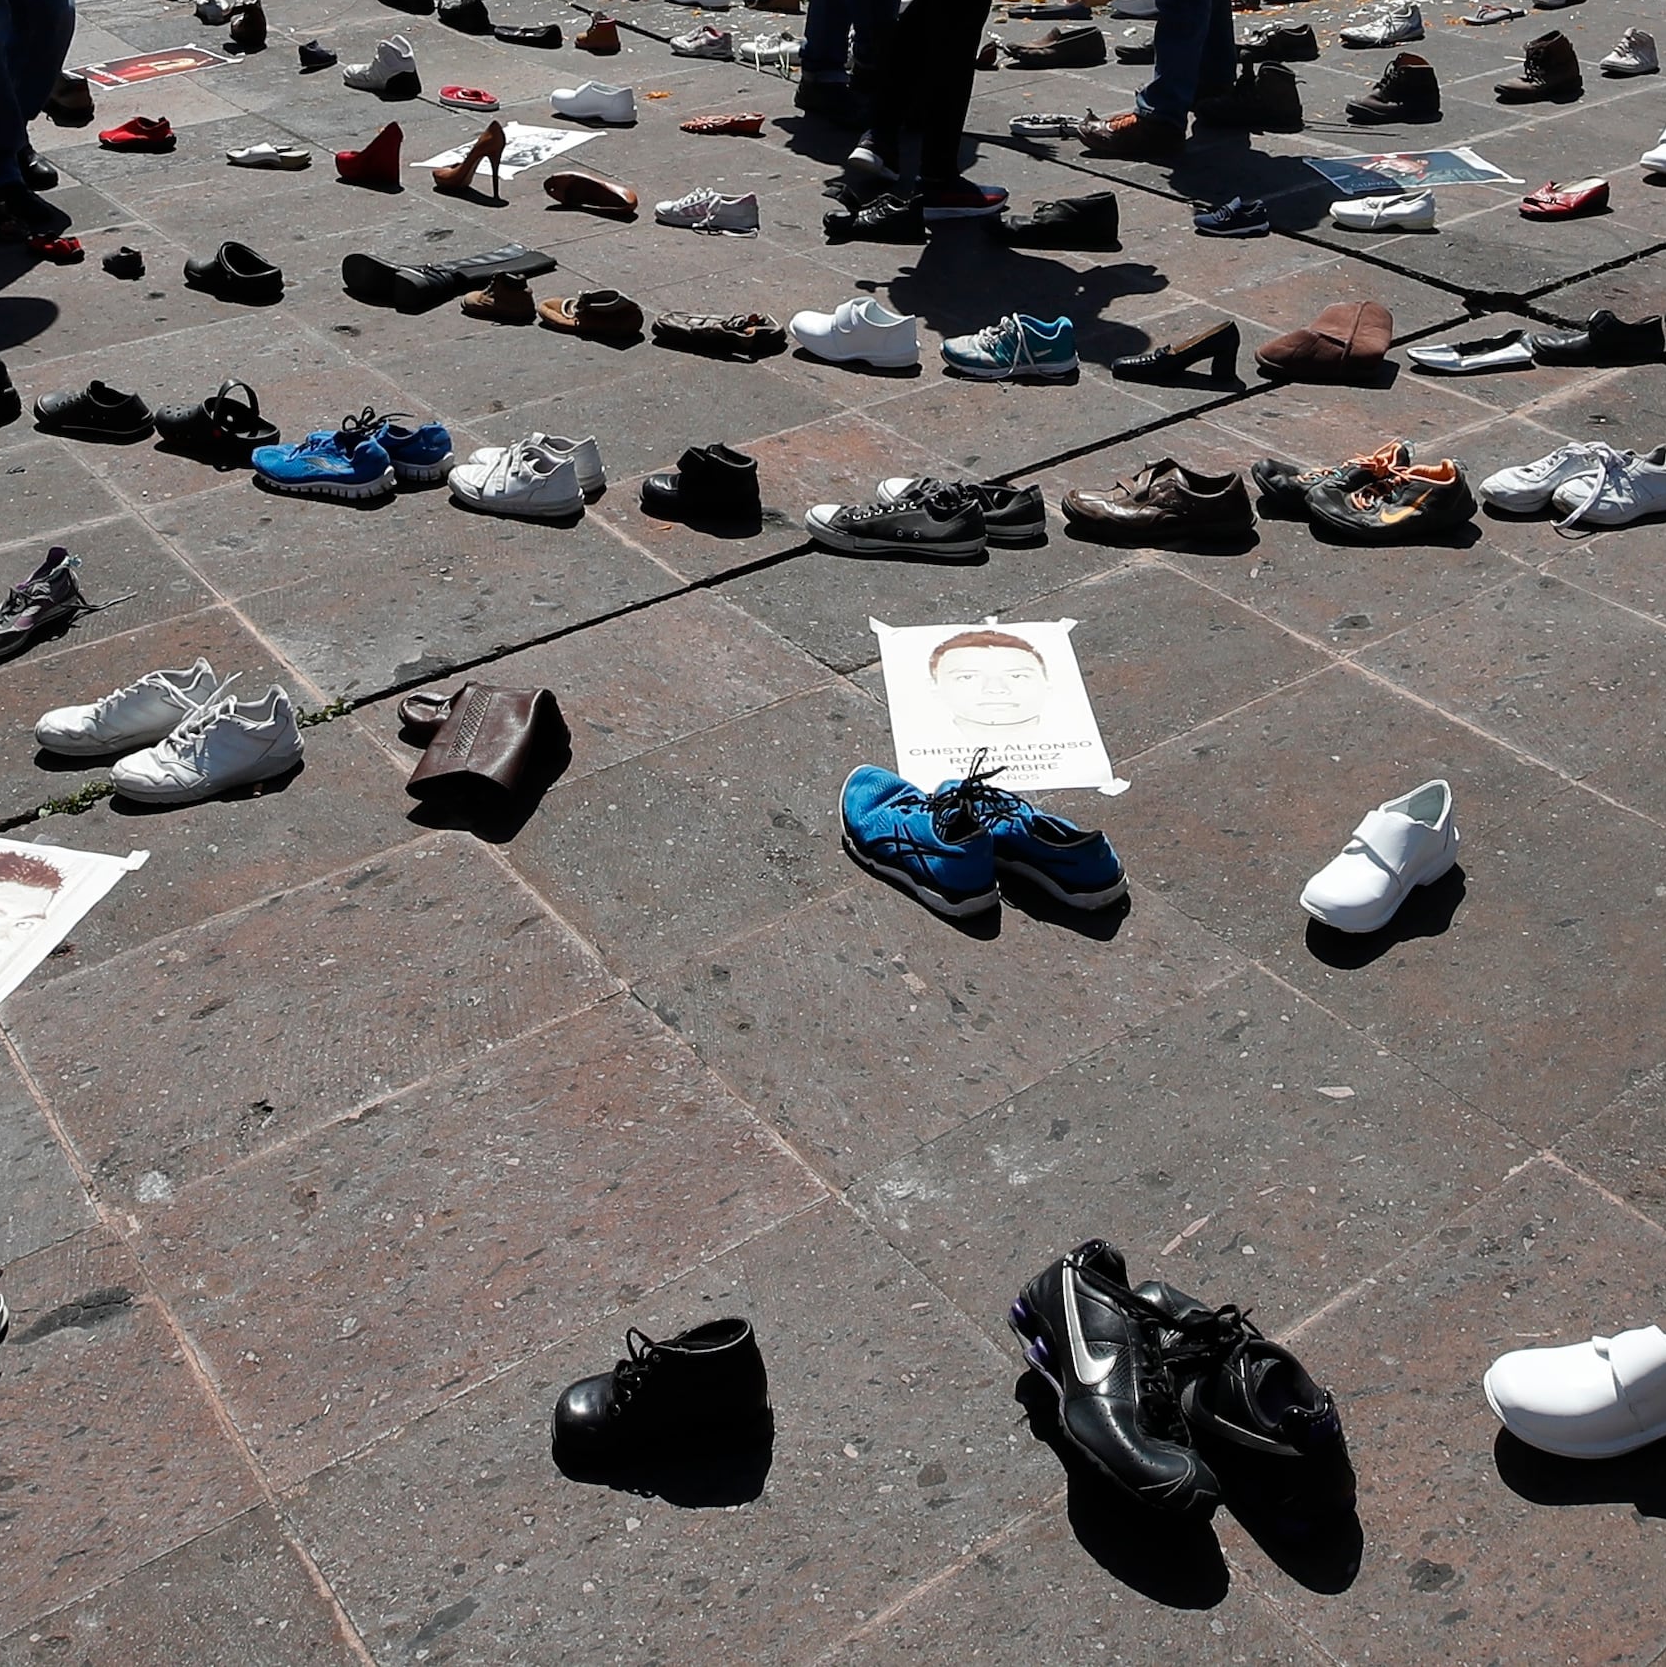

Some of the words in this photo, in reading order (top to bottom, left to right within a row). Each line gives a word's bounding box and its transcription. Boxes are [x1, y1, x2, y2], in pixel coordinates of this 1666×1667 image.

[909, 746, 998, 757] CHISTIAN
[1004, 740, 1093, 752] ALFONSO
[949, 752, 1064, 765] RODRÍGUEZ
[956, 762, 1060, 775] TLMBRE
